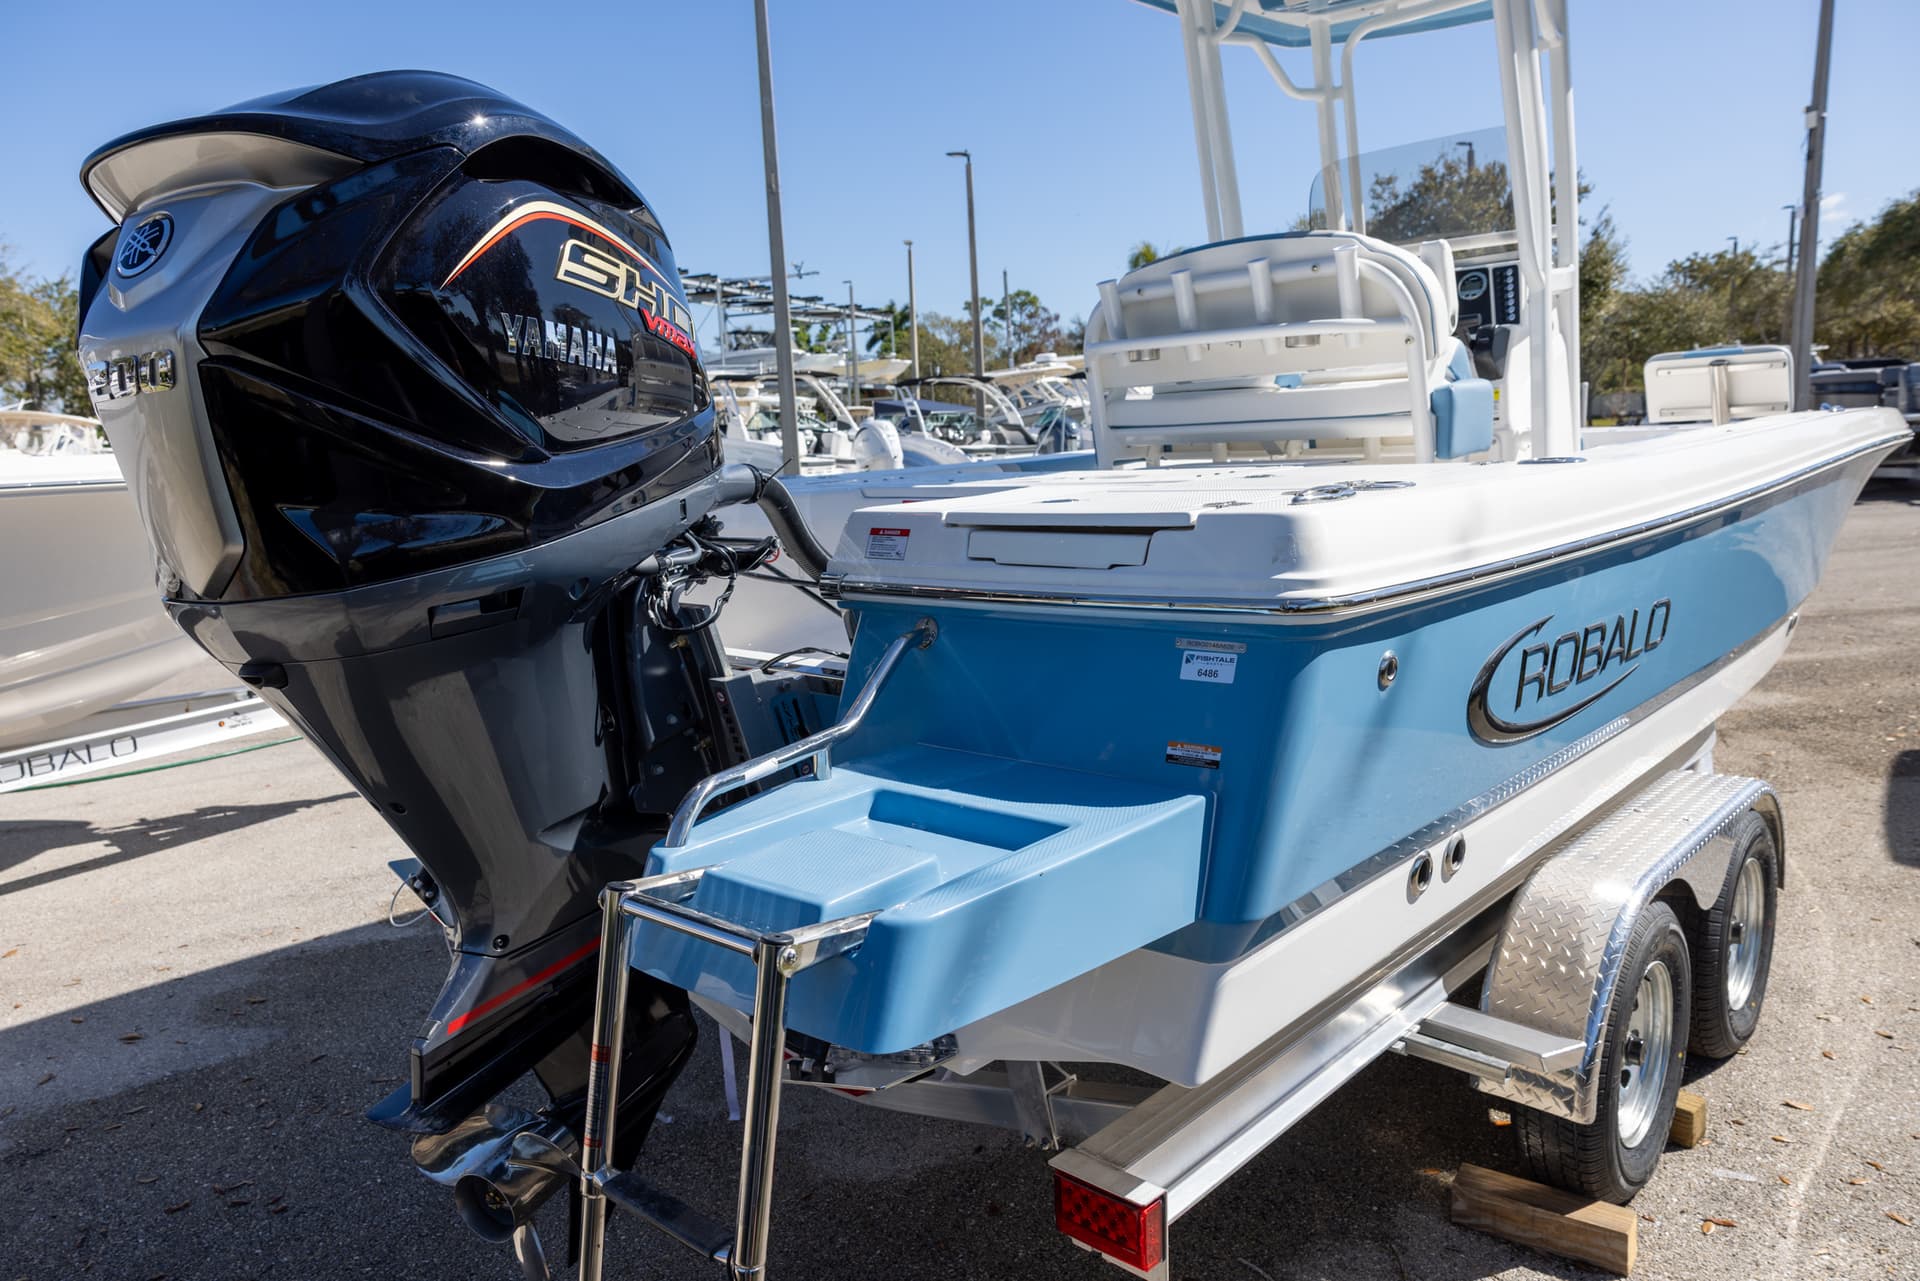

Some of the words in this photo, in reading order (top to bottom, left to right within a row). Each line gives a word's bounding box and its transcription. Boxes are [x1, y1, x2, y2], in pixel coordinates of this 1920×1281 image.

[501, 311, 617, 374] YAMAHA
[1195, 655, 1236, 664] FISHTALE
[1197, 668, 1219, 678] 6486
[1514, 598, 1671, 713] ROBALO
[0, 736, 138, 784] OBALO
